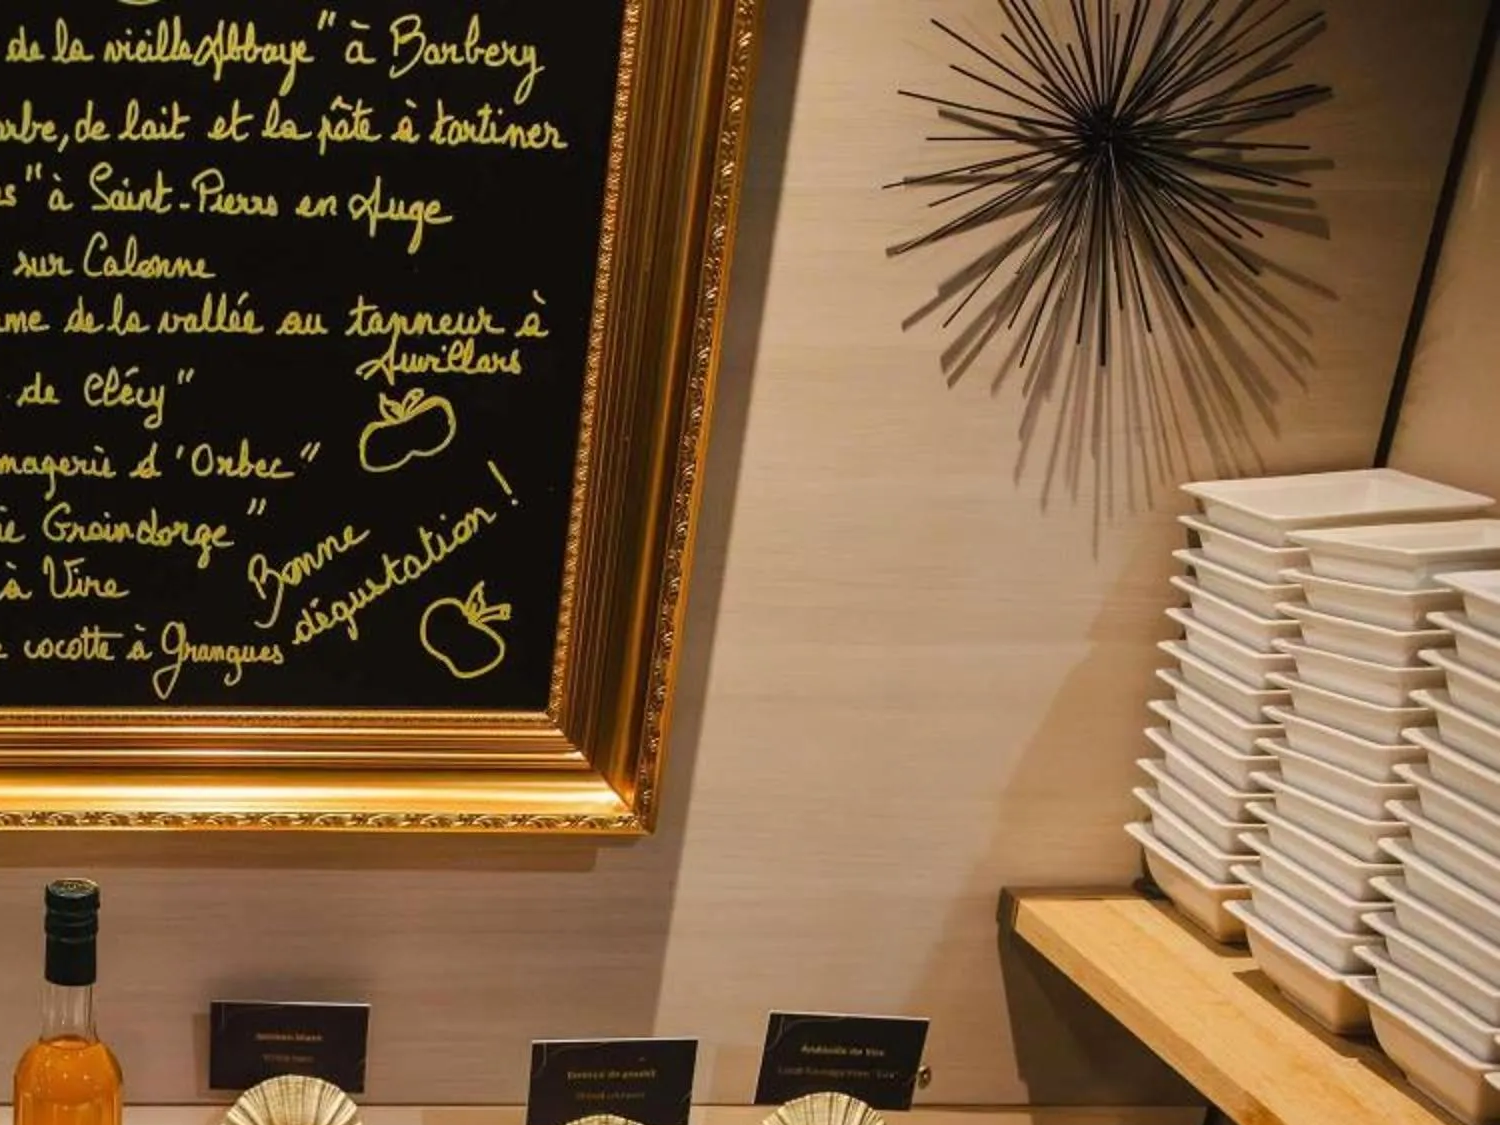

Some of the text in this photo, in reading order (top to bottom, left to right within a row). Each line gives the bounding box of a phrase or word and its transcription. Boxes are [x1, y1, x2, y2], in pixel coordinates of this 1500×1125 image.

[6, 26, 45, 62] de
[52, 18, 94, 64] la
[104, 16, 192, 62] vieille
[345, 20, 376, 64] à
[389, 14, 545, 103] Barbery
[75, 100, 110, 143] de
[118, 99, 190, 140] lait
[208, 99, 254, 141] et
[262, 98, 312, 140] la
[317, 96, 382, 155] pâte
[391, 99, 420, 143] à
[429, 99, 568, 148] tartiner
[48, 173, 73, 211] à
[295, 195, 337, 217] en
[348, 176, 452, 254] Auge
[13, 251, 73, 277] sur
[83, 232, 216, 278] Calonne
[64, 296, 104, 333] de
[107, 293, 150, 336] la
[158, 292, 264, 334] vallée
[276, 312, 328, 335] au
[515, 290, 549, 337] à
[17, 372, 60, 406] de
[43, 556, 129, 598] Vire
[248, 526, 370, 628] Bonne
[292, 508, 496, 644] dégustation
[24, 626, 123, 660] cocotte
[126, 624, 152, 660] à
